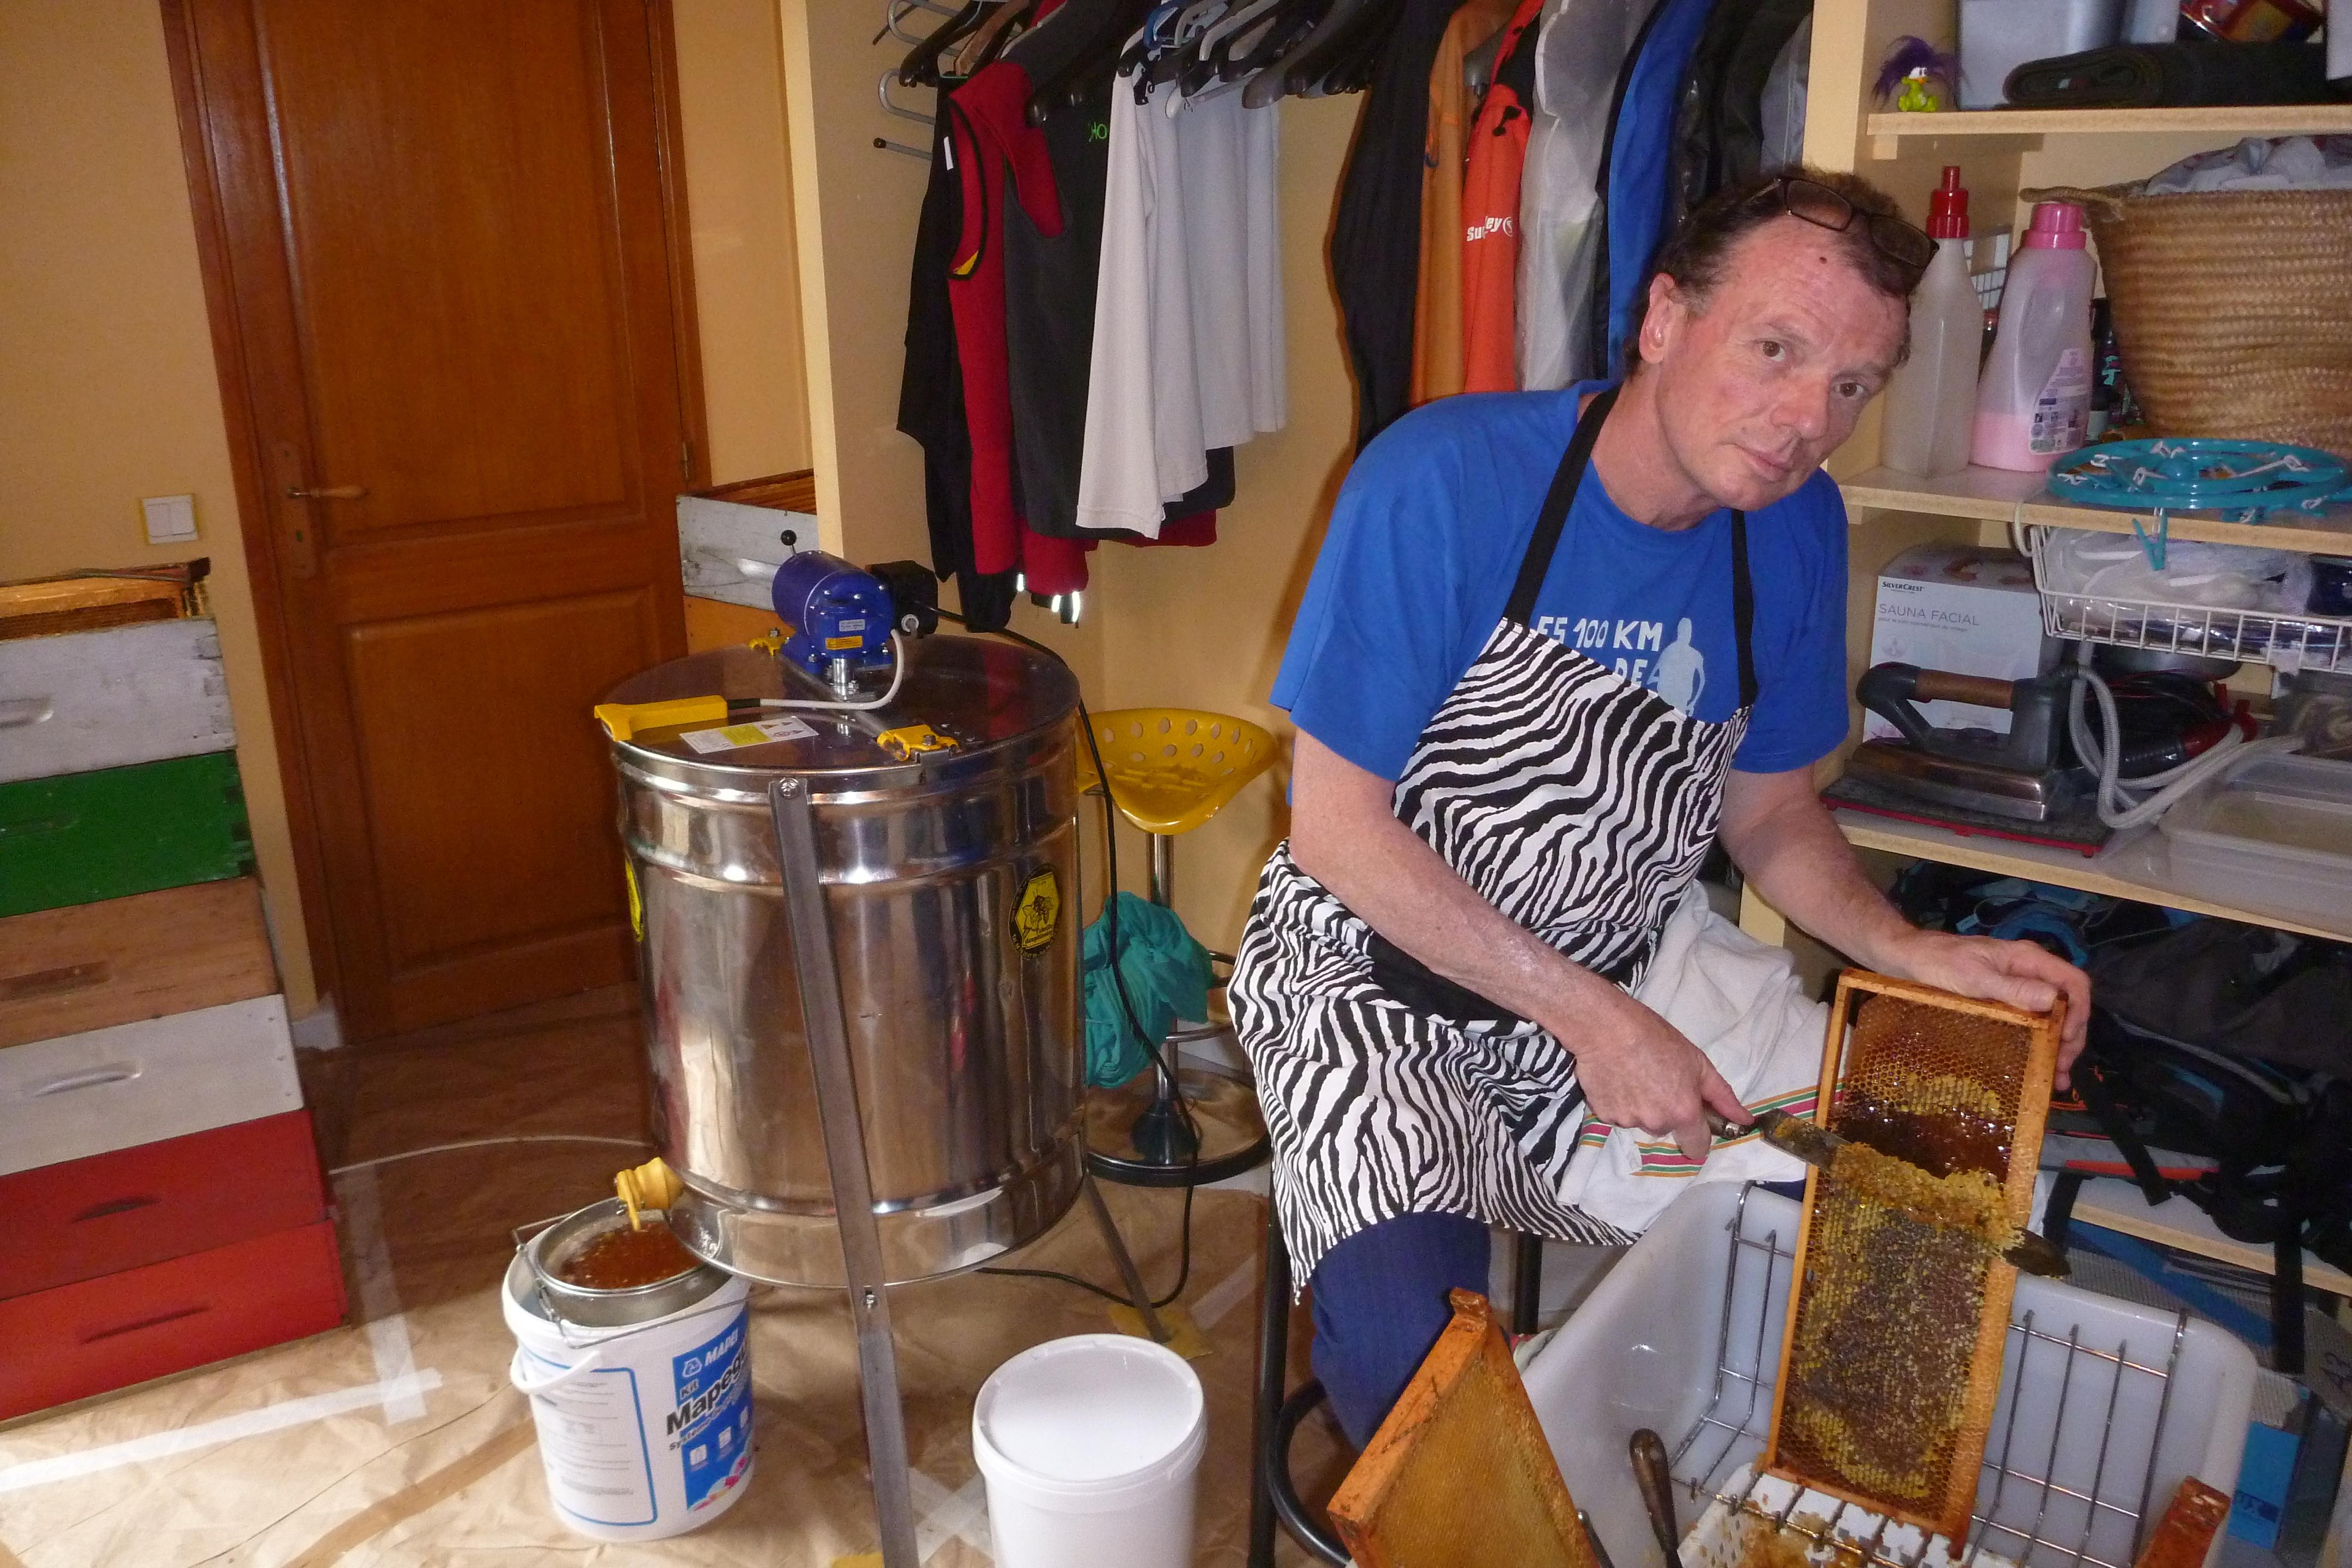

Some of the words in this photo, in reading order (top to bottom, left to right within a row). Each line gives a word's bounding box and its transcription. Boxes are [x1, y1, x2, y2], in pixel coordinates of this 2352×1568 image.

[1879, 603, 1926, 619] SAUNA
[1931, 610, 1980, 626] FACIAL
[1573, 618, 1609, 648] 100
[1613, 620, 1663, 652] KM
[1615, 658, 1648, 685] DE
